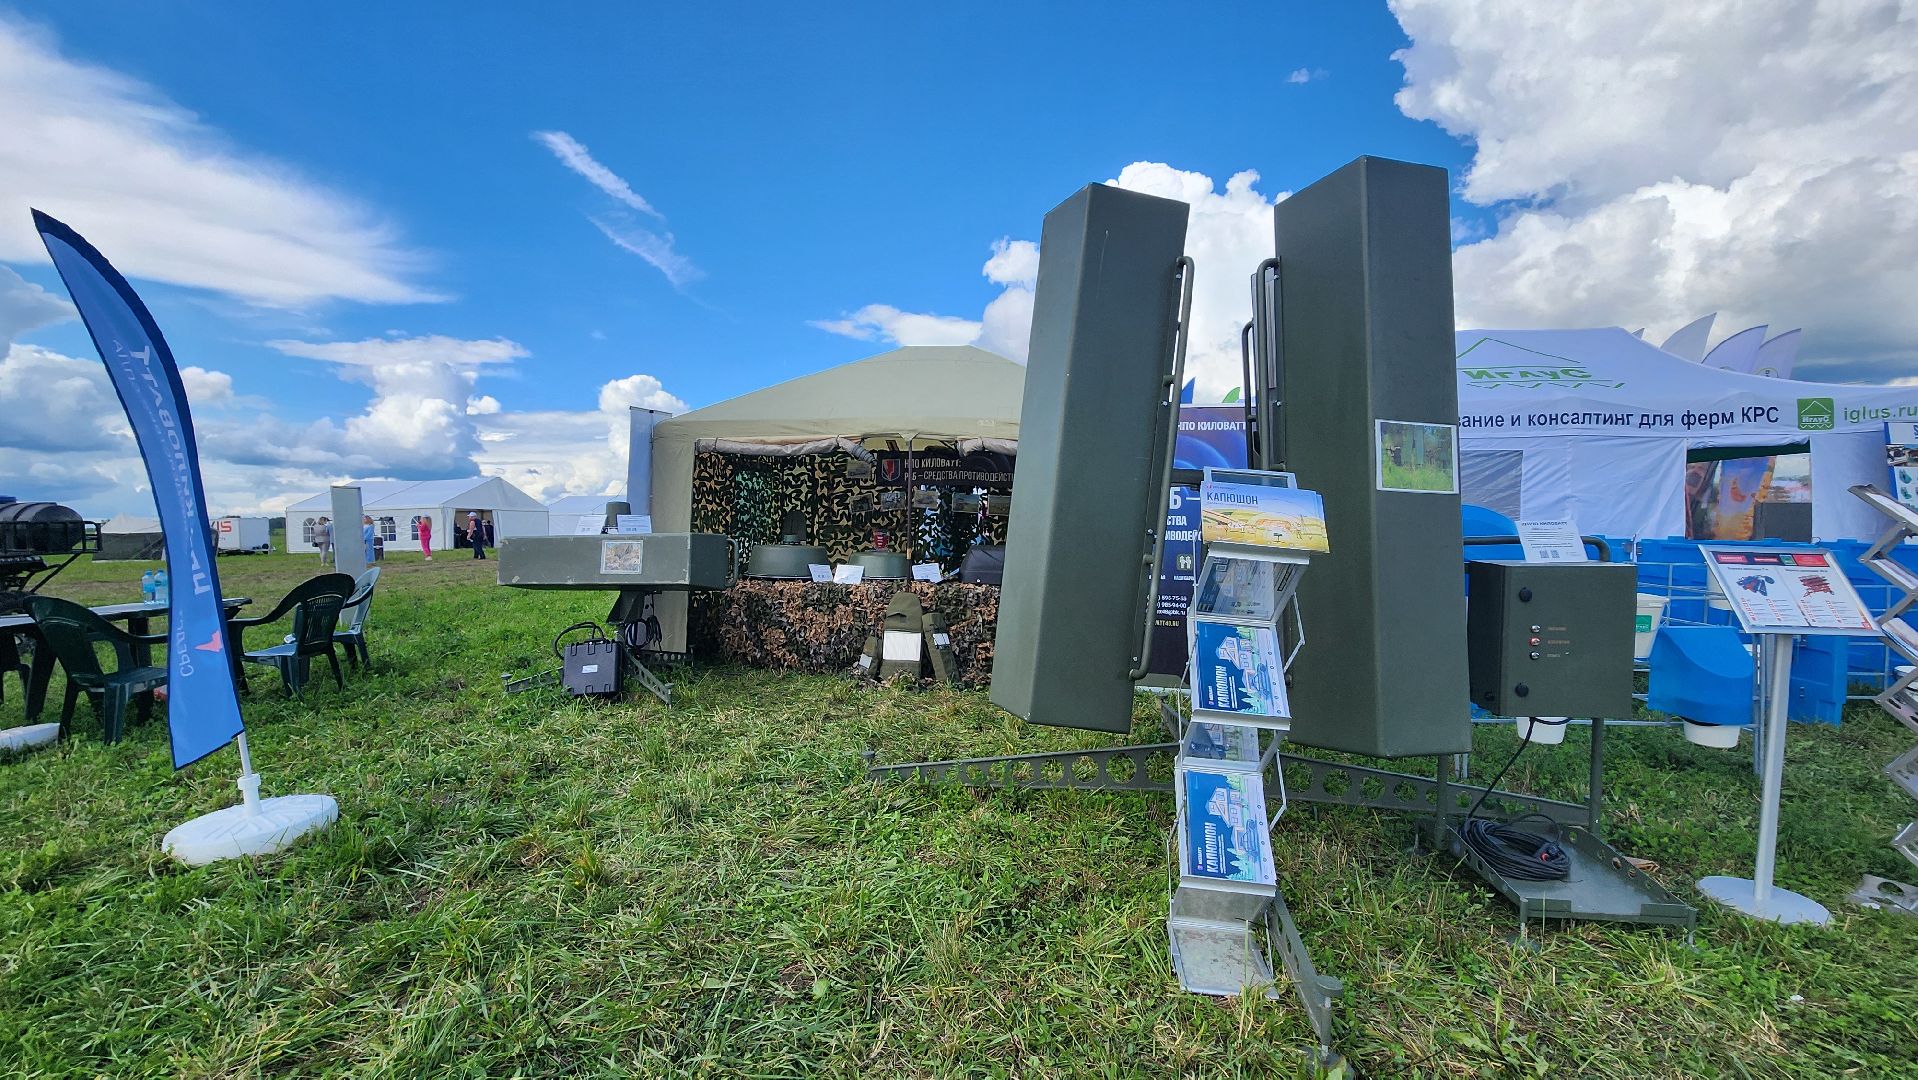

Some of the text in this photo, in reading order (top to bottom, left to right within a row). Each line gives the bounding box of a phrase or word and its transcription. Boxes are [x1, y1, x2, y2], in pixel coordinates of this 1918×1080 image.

[1511, 414, 1521, 427] и
[1528, 411, 1634, 427] консалтинг
[1639, 413, 1674, 429] для
[1681, 410, 1734, 429] ферм
[1741, 406, 1779, 424] КРС
[1843, 405, 1918, 424] iglus.ru
[1198, 421, 1247, 431] КИЛОВАТТ
[904, 472, 917, 481] РБ
[959, 470, 1015, 482] ПРОТИВОДЕЙСТ
[1206, 492, 1258, 505] КАПЮШОН
[1215, 665, 1230, 709] КАПЮШОН
[1204, 822, 1219, 874] КАПЮШОН
